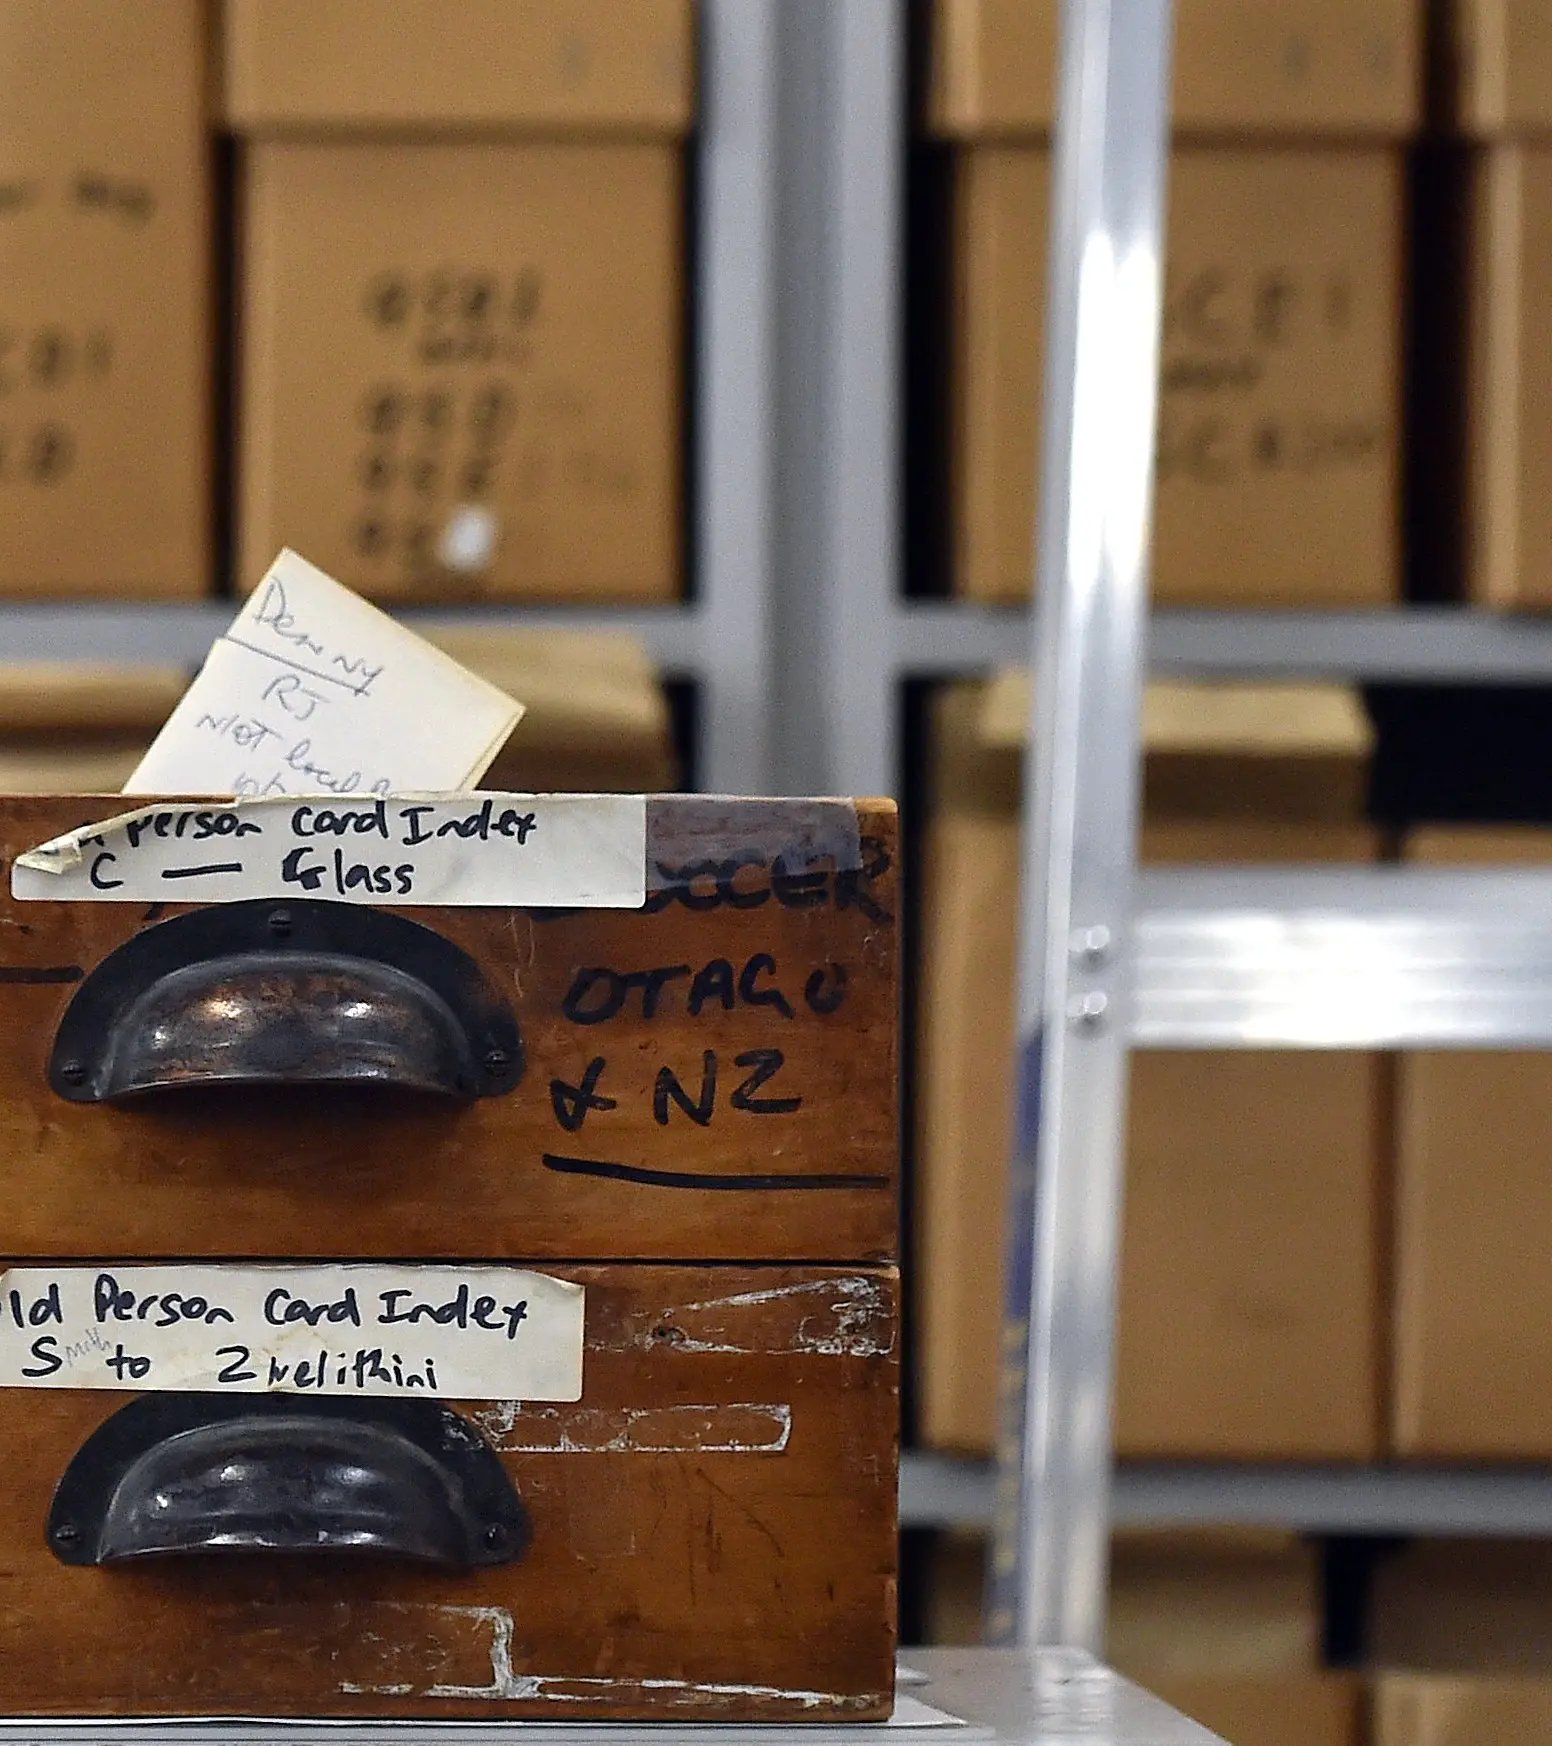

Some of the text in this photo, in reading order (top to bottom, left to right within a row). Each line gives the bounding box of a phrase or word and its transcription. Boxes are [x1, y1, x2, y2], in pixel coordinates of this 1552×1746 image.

[261, 674, 329, 720] RJ
[400, 804, 537, 847] Index
[90, 851, 125, 890] C
[281, 846, 415, 896] Glass
[560, 952, 848, 1026] OTAGO
[652, 1048, 803, 1128] NZ
[93, 1273, 236, 1327] Person
[264, 1287, 361, 1327] Card
[378, 1283, 528, 1340] Index
[105, 1343, 151, 1381] to
